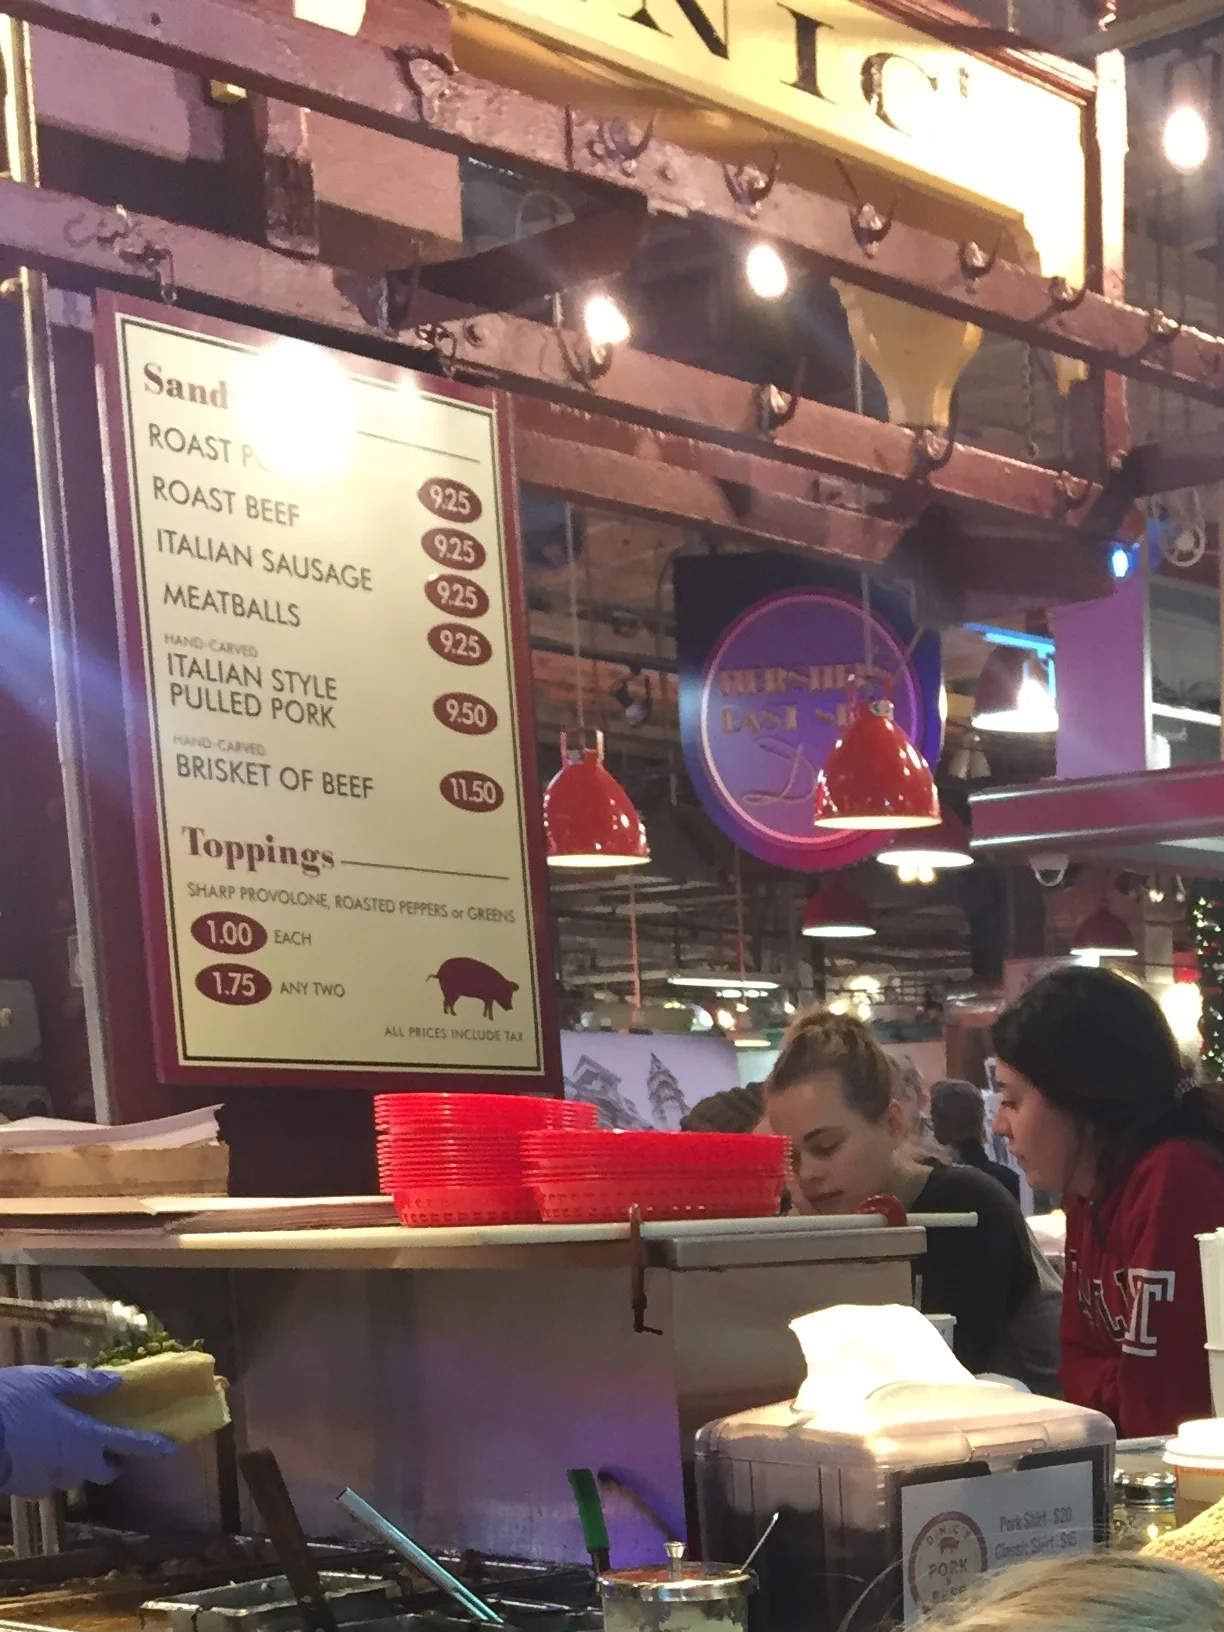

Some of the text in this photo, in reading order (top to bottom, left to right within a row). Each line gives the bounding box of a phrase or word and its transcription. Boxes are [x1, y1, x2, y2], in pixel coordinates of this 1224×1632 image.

[148, 423, 231, 463] ROAST
[152, 475, 300, 527] ROAST BEEF
[429, 485, 472, 515] 9.25
[157, 528, 373, 592] ITALIAN SAUSAGE
[434, 534, 476, 564] 9.25
[163, 582, 301, 628] MEATBALLS
[437, 580, 479, 610] 9.25
[440, 629, 482, 658] 9.25
[168, 652, 338, 701] ITALIAN STYLE
[170, 683, 337, 729] PULLED PORK
[445, 698, 488, 728] 9.50
[176, 753, 374, 799] BRISKET OF BEEF
[450, 777, 497, 804] 11.50
[181, 825, 335, 878] Toppings
[187, 881, 236, 900] SHARP
[239, 886, 331, 910] PROVOLONE,
[335, 894, 396, 914] ROASTED
[399, 900, 449, 918] PEPPERS
[467, 906, 516, 924] GREENS
[207, 920, 312, 946] 1.00 EACH
[212, 972, 346, 998] 1.75 ANY TWO
[384, 1026, 524, 1042] ALL PRICES INCLUDE TAX
